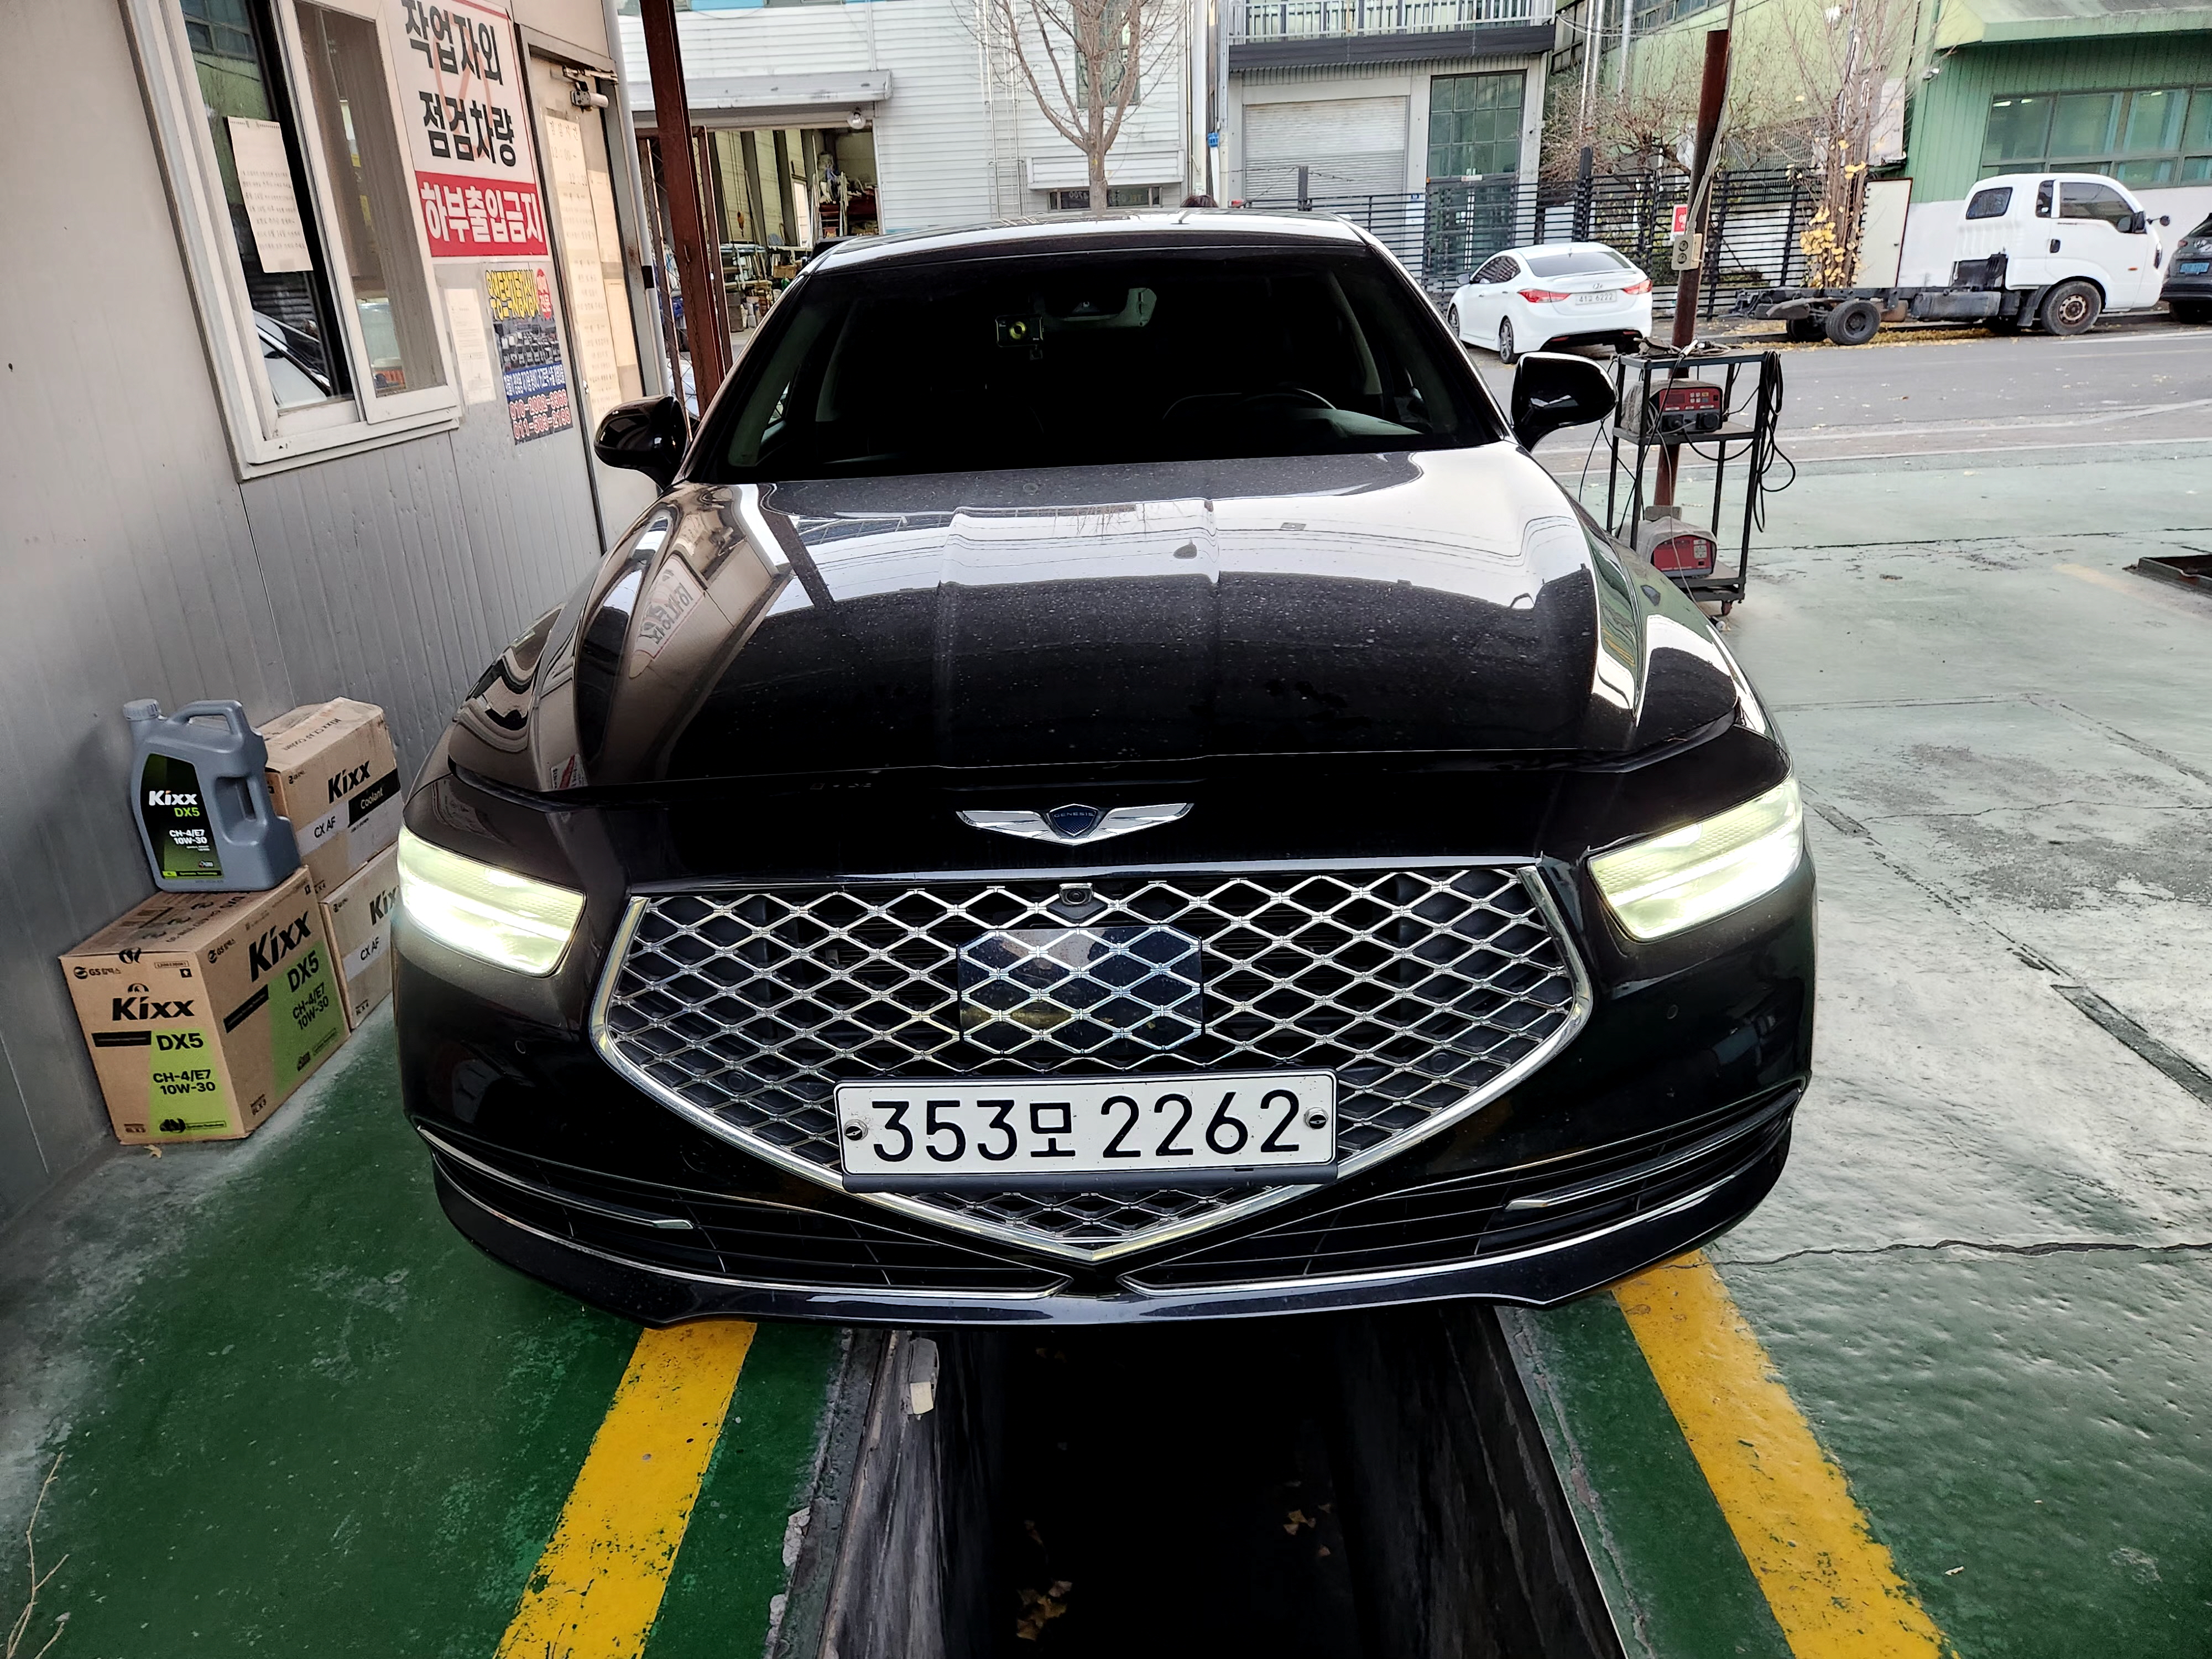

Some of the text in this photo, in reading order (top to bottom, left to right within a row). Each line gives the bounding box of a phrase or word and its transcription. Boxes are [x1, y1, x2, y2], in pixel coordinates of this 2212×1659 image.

[401, 0, 504, 86] 작업자외
[419, 91, 517, 167] 점검차량
[420, 181, 544, 243] 하부출입금지
[328, 760, 371, 804] Kixx
[149, 790, 197, 806] Kixx
[360, 787, 384, 810] Coolant
[174, 807, 200, 817] DX5
[169, 829, 205, 837] CH-4/E7
[314, 822, 325, 838] CX
[326, 816, 336, 832] AF
[174, 836, 207, 845] 10W-30
[249, 911, 311, 983] Kixx
[287, 950, 319, 993] DX5
[112, 996, 195, 1021] Kixx
[293, 982, 325, 1019] CH-4/E7
[298, 996, 329, 1030] 10W-30
[155, 1032, 204, 1051] DX5
[153, 1069, 211, 1083] CH-4/E7
[160, 1082, 216, 1095] 10W-30
[872, 1089, 1300, 1162] 353모 2262
